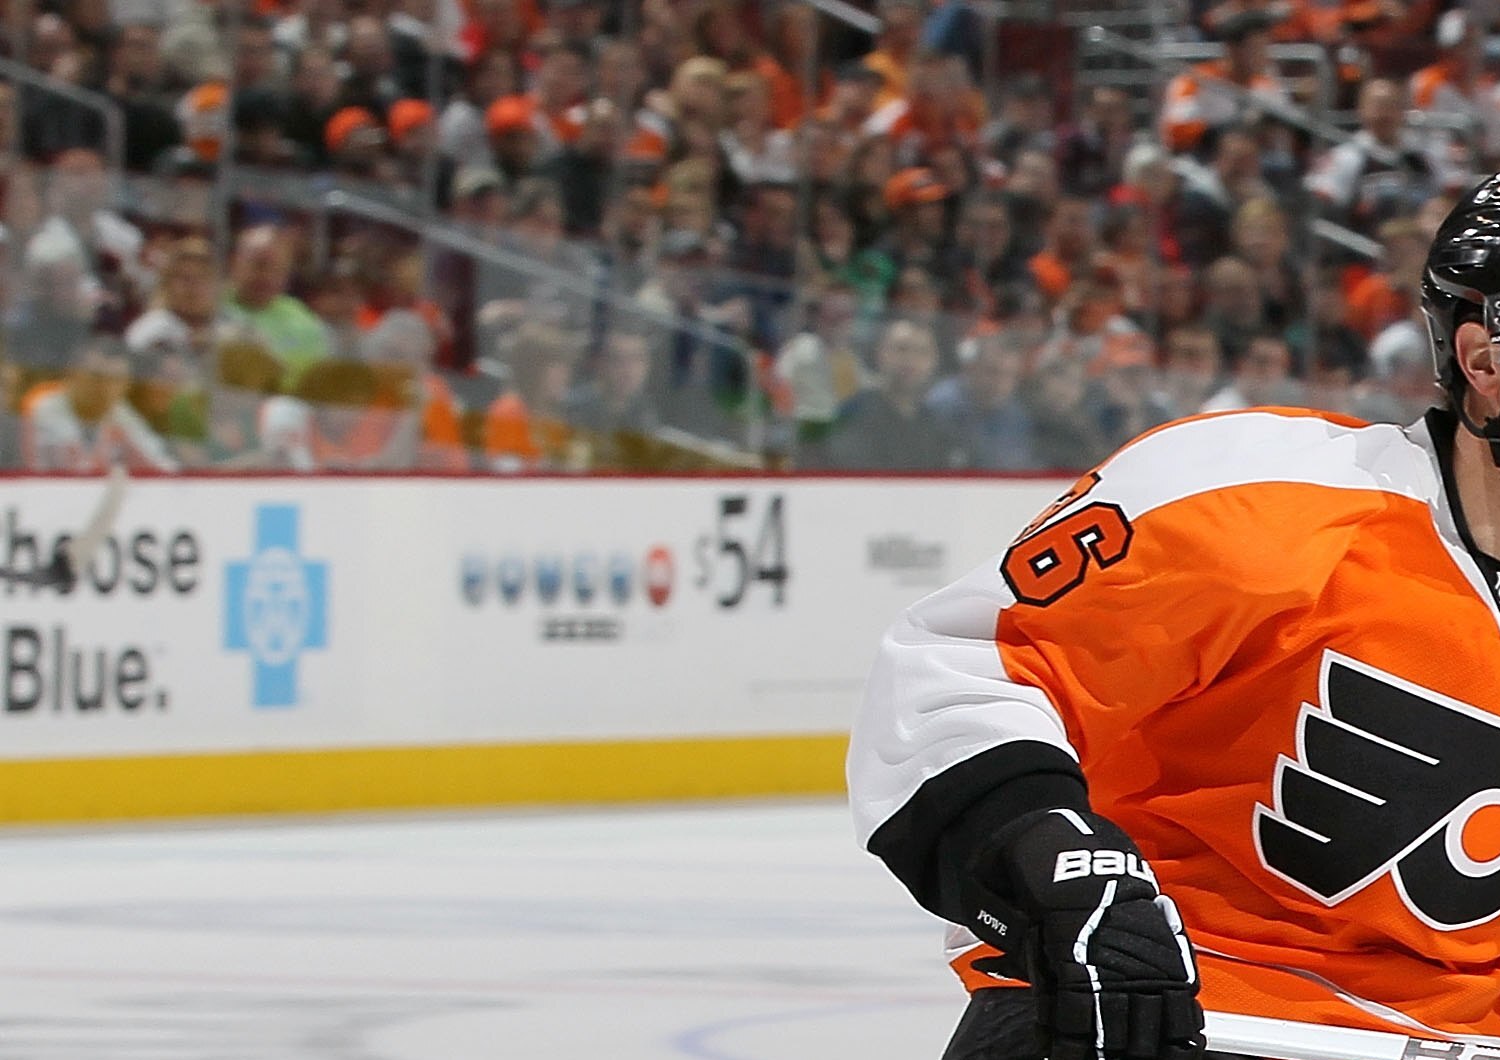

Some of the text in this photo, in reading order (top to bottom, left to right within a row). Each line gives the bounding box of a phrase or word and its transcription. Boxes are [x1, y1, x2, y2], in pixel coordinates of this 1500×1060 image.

[1000, 472, 1134, 607] 6
[6, 624, 168, 714] Blue.
[1053, 849, 1160, 895] BAU
[977, 909, 1008, 936] POWE
